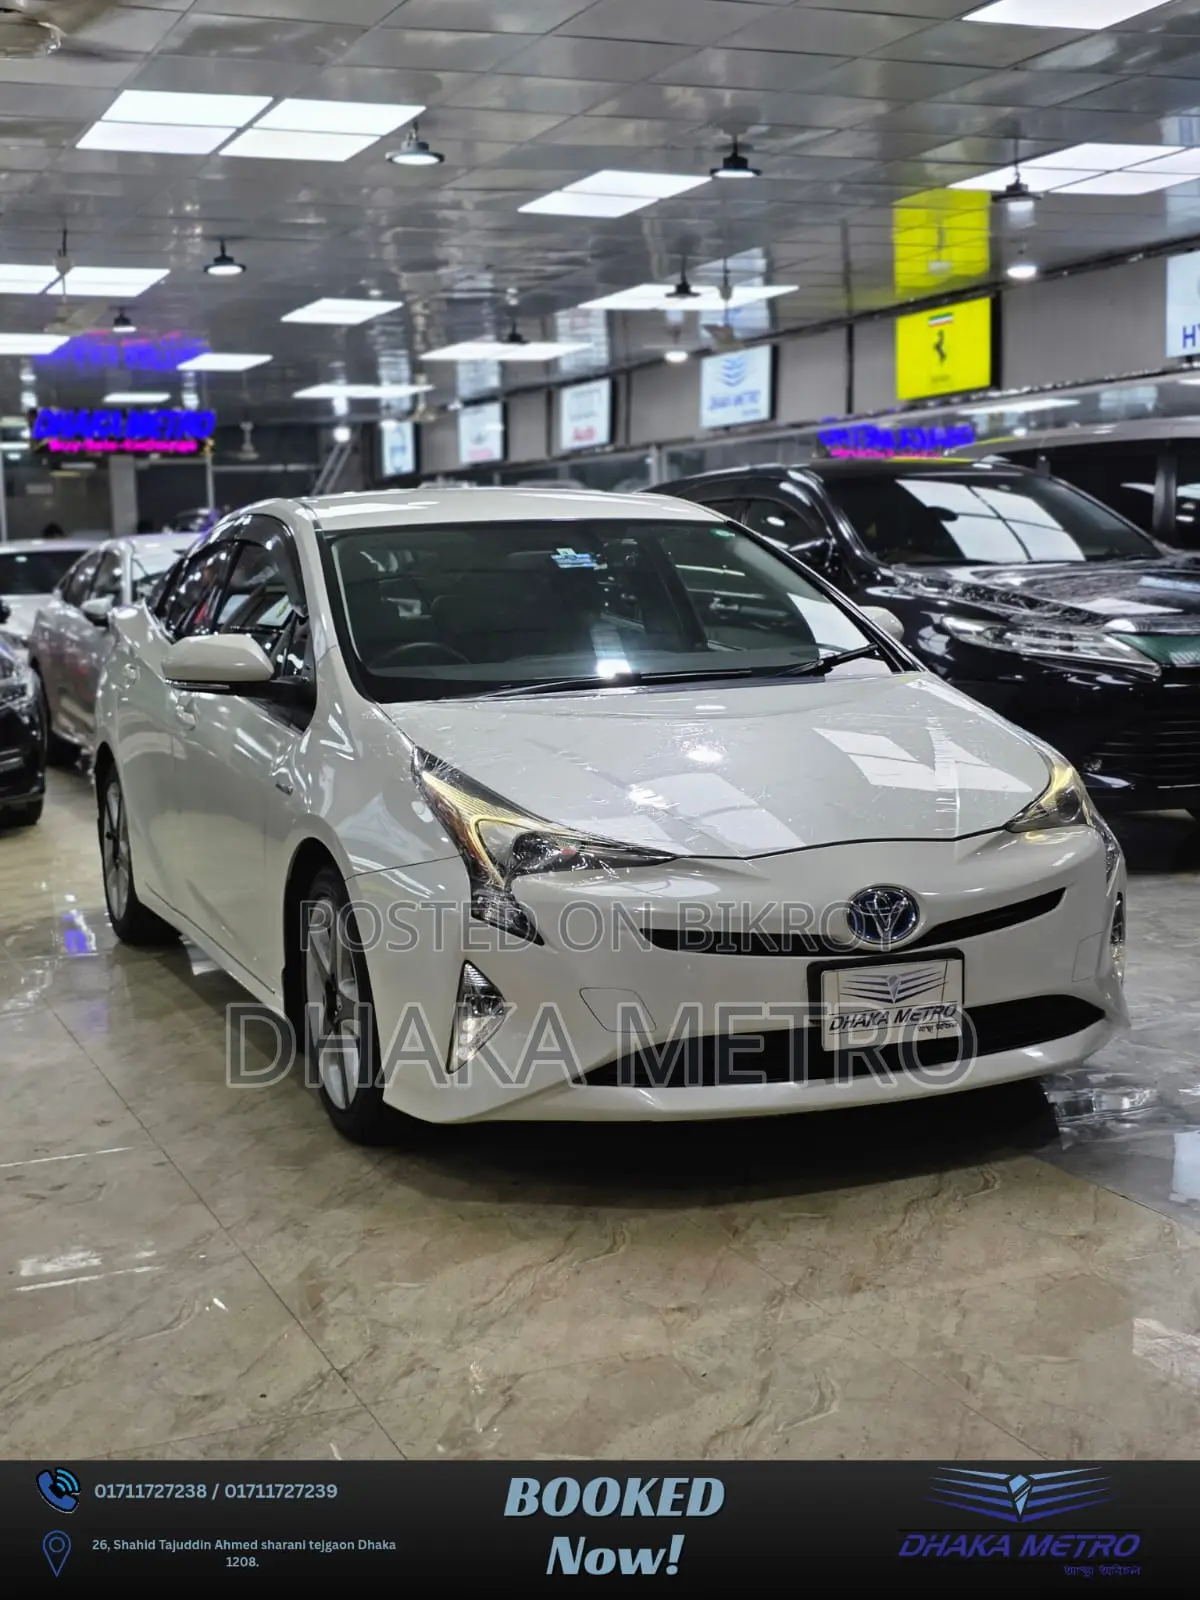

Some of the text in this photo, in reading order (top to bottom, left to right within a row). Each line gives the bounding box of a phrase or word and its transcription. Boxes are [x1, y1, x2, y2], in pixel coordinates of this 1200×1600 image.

[1182, 323, 1200, 349] H
[829, 1004, 957, 1031] DHAKA METRO
